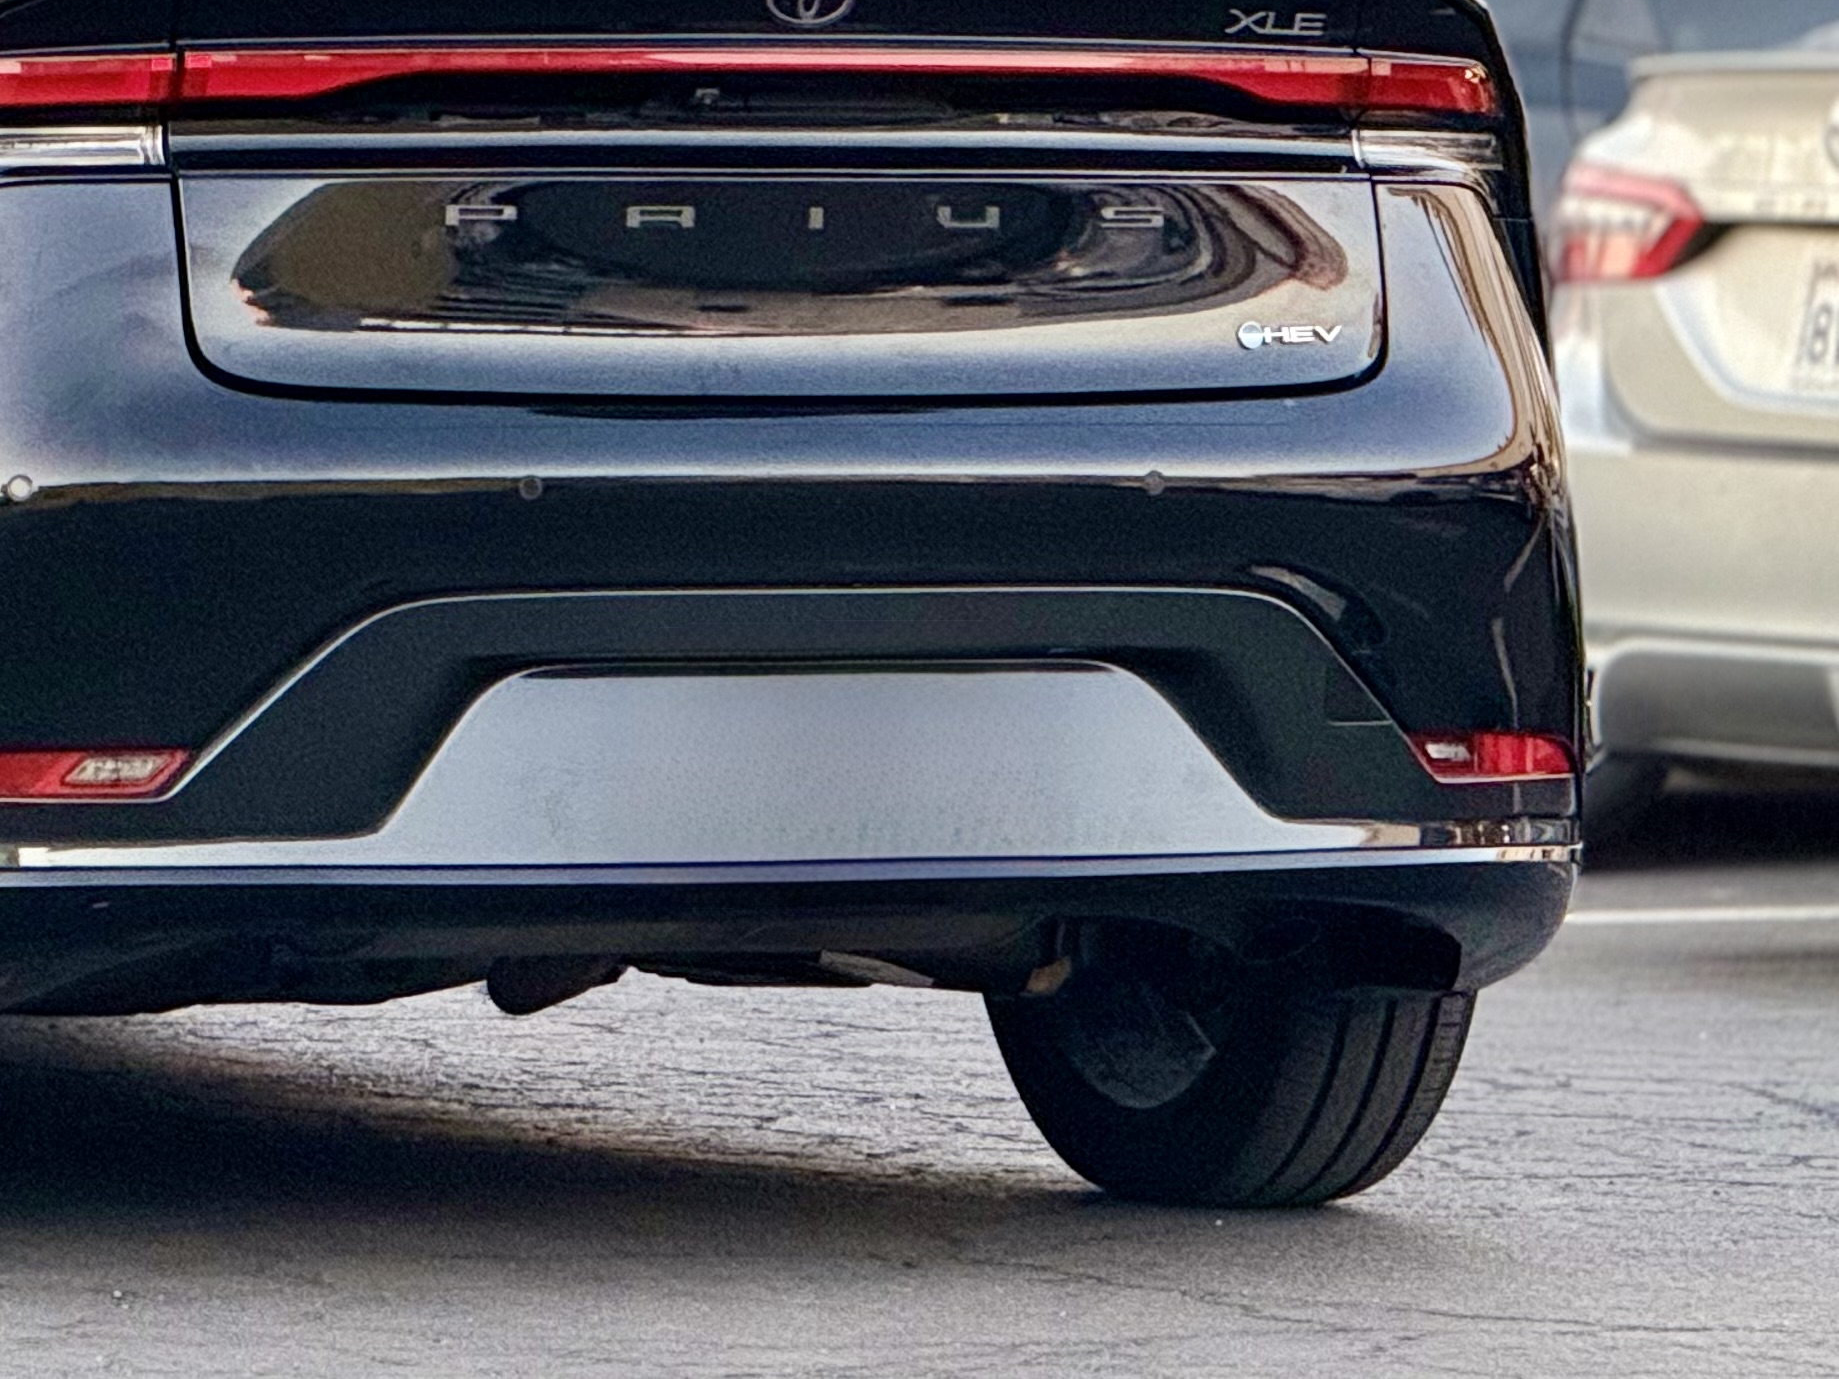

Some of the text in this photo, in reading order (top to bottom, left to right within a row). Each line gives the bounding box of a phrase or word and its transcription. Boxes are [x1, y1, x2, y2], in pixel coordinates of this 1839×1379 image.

[1224, 8, 1327, 36] XLE
[446, 204, 1164, 229] PRIUS
[1262, 325, 1342, 343] HEV
